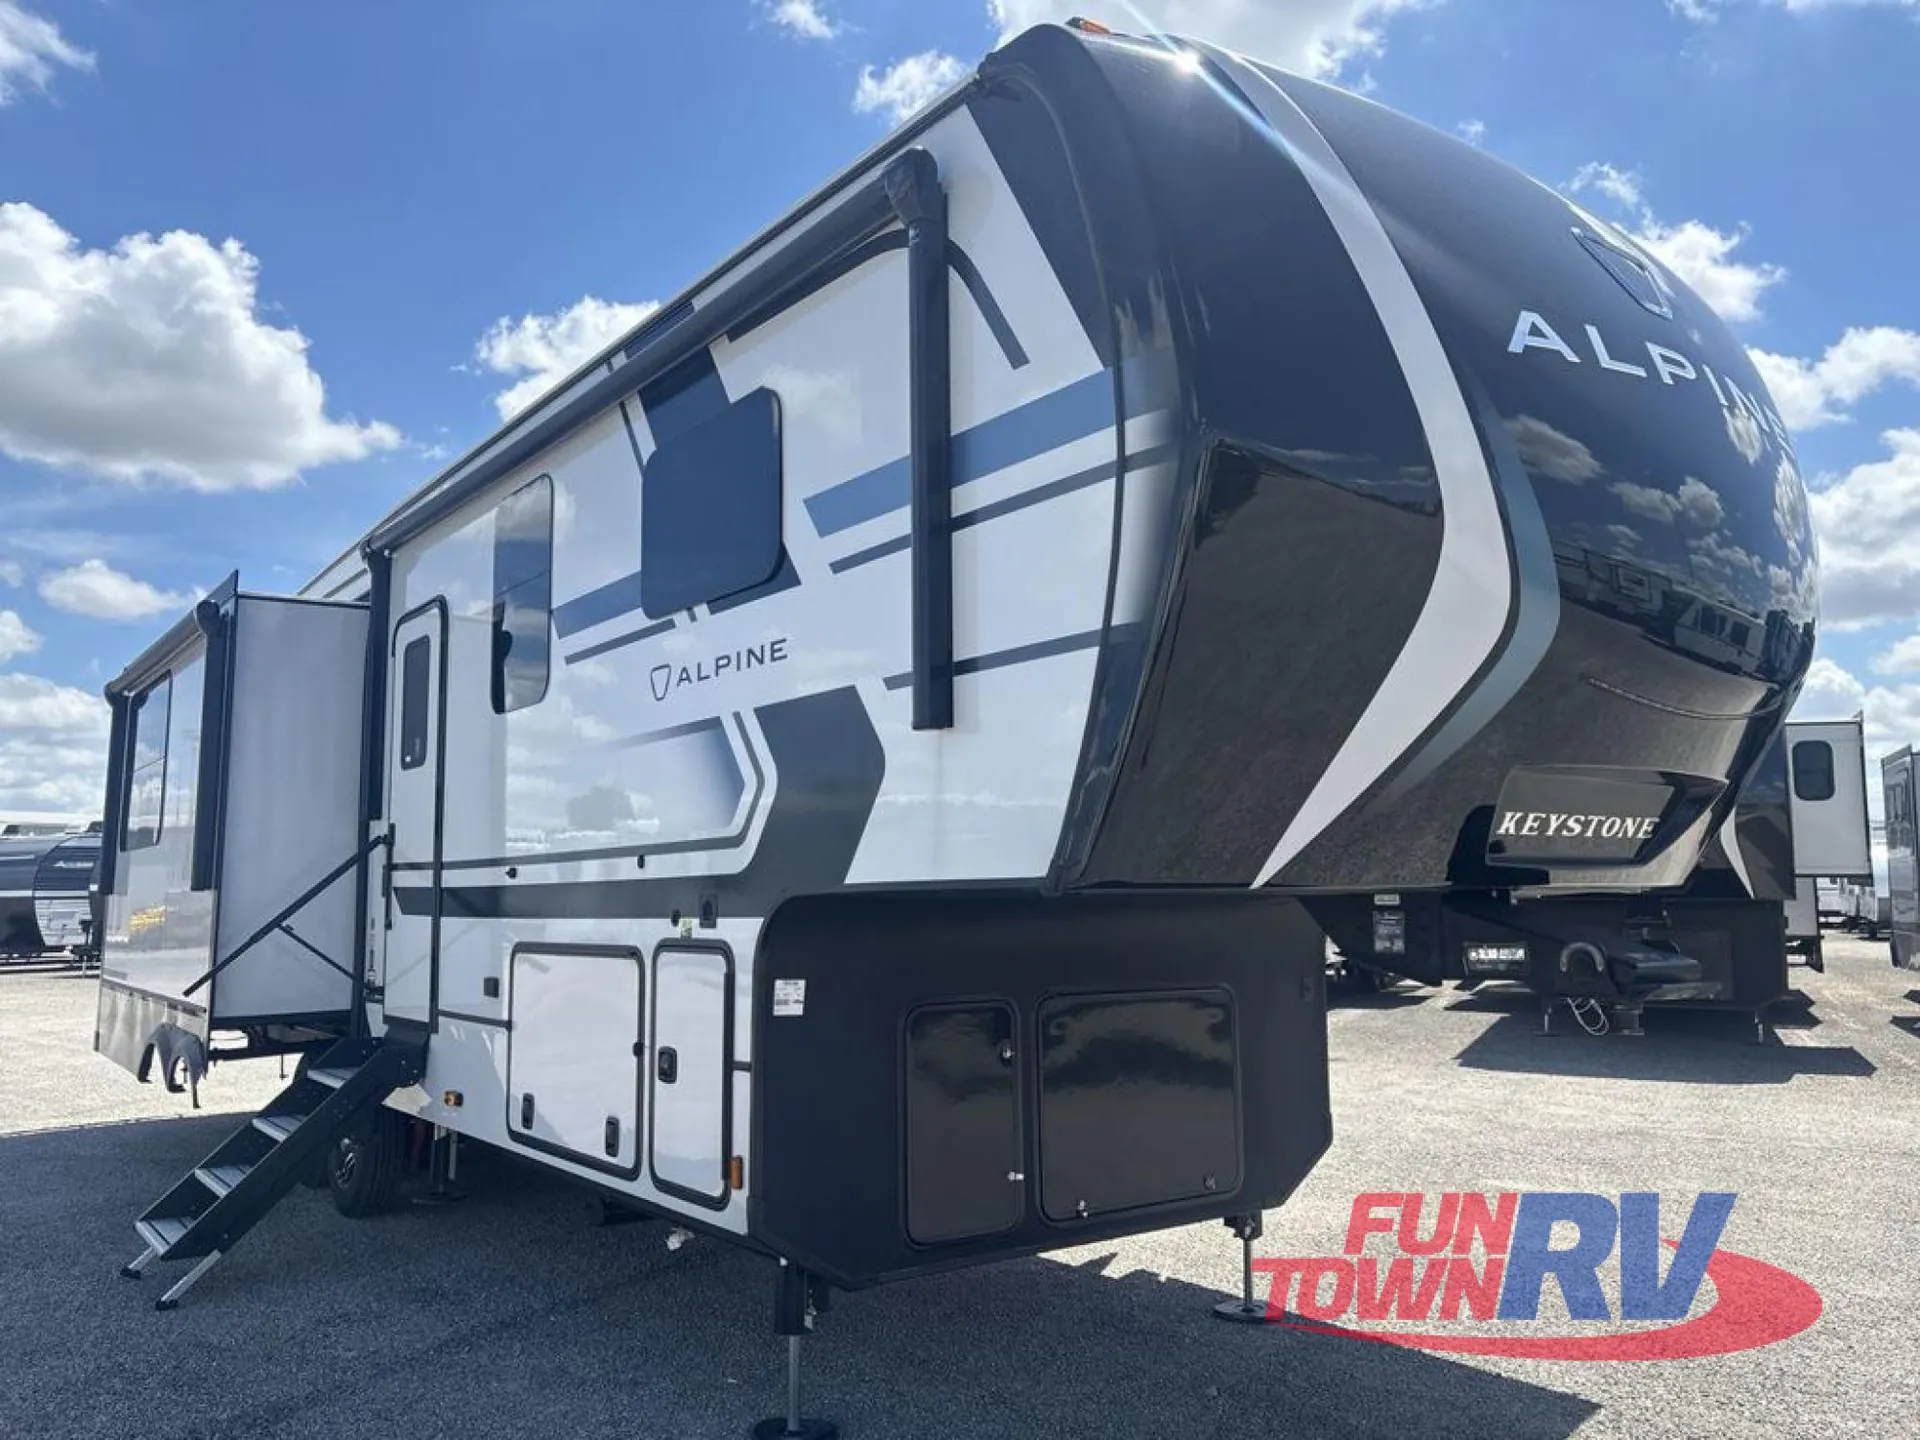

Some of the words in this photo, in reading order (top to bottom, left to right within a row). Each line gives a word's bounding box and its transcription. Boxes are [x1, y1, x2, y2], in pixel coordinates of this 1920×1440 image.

[1507, 309, 1796, 460] ALPINE
[676, 638, 789, 688] ALPINE
[1496, 811, 1661, 840] KEYSTONE
